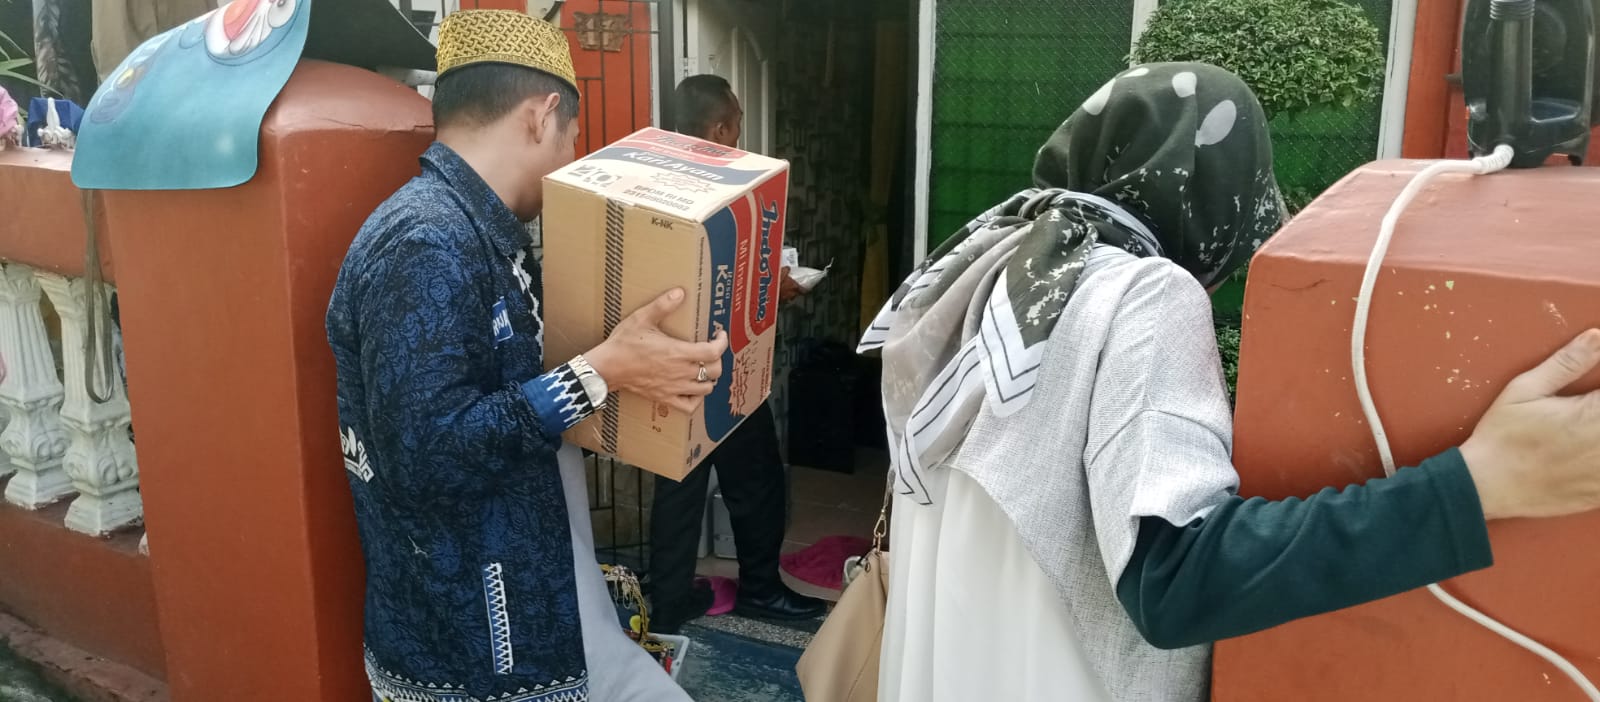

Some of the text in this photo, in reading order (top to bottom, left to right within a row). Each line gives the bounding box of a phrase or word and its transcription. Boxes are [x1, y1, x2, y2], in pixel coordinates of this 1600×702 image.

[623, 151, 673, 165] Kari
[663, 162, 725, 181] Ayam
[713, 264, 729, 317] Kari
[724, 271, 733, 299] Rasa
[734, 238, 749, 312] Mi Instan
